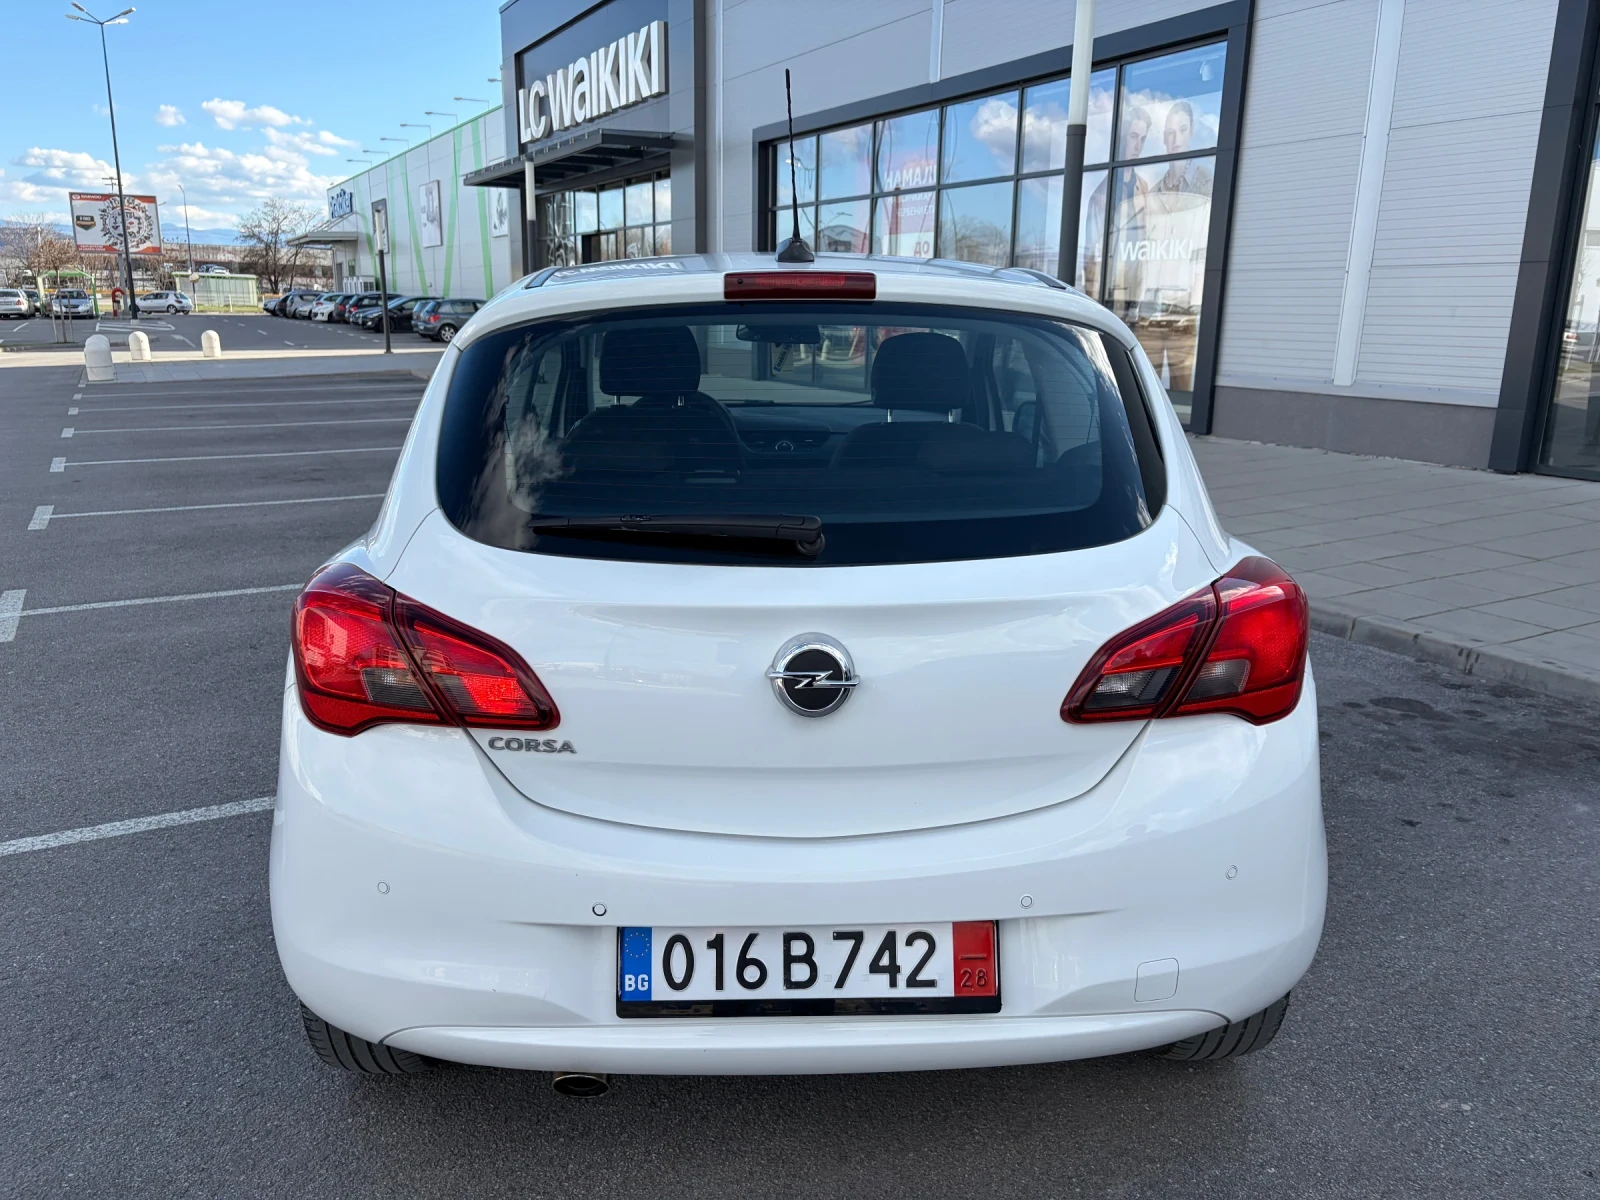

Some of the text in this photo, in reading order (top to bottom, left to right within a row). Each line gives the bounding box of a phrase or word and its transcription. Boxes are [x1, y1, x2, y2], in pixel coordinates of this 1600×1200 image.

[518, 80, 549, 144] LC
[884, 165, 937, 190] НАМАЛ
[488, 736, 578, 754] CORSA
[624, 974, 649, 991] BG
[960, 967, 987, 988] 28
